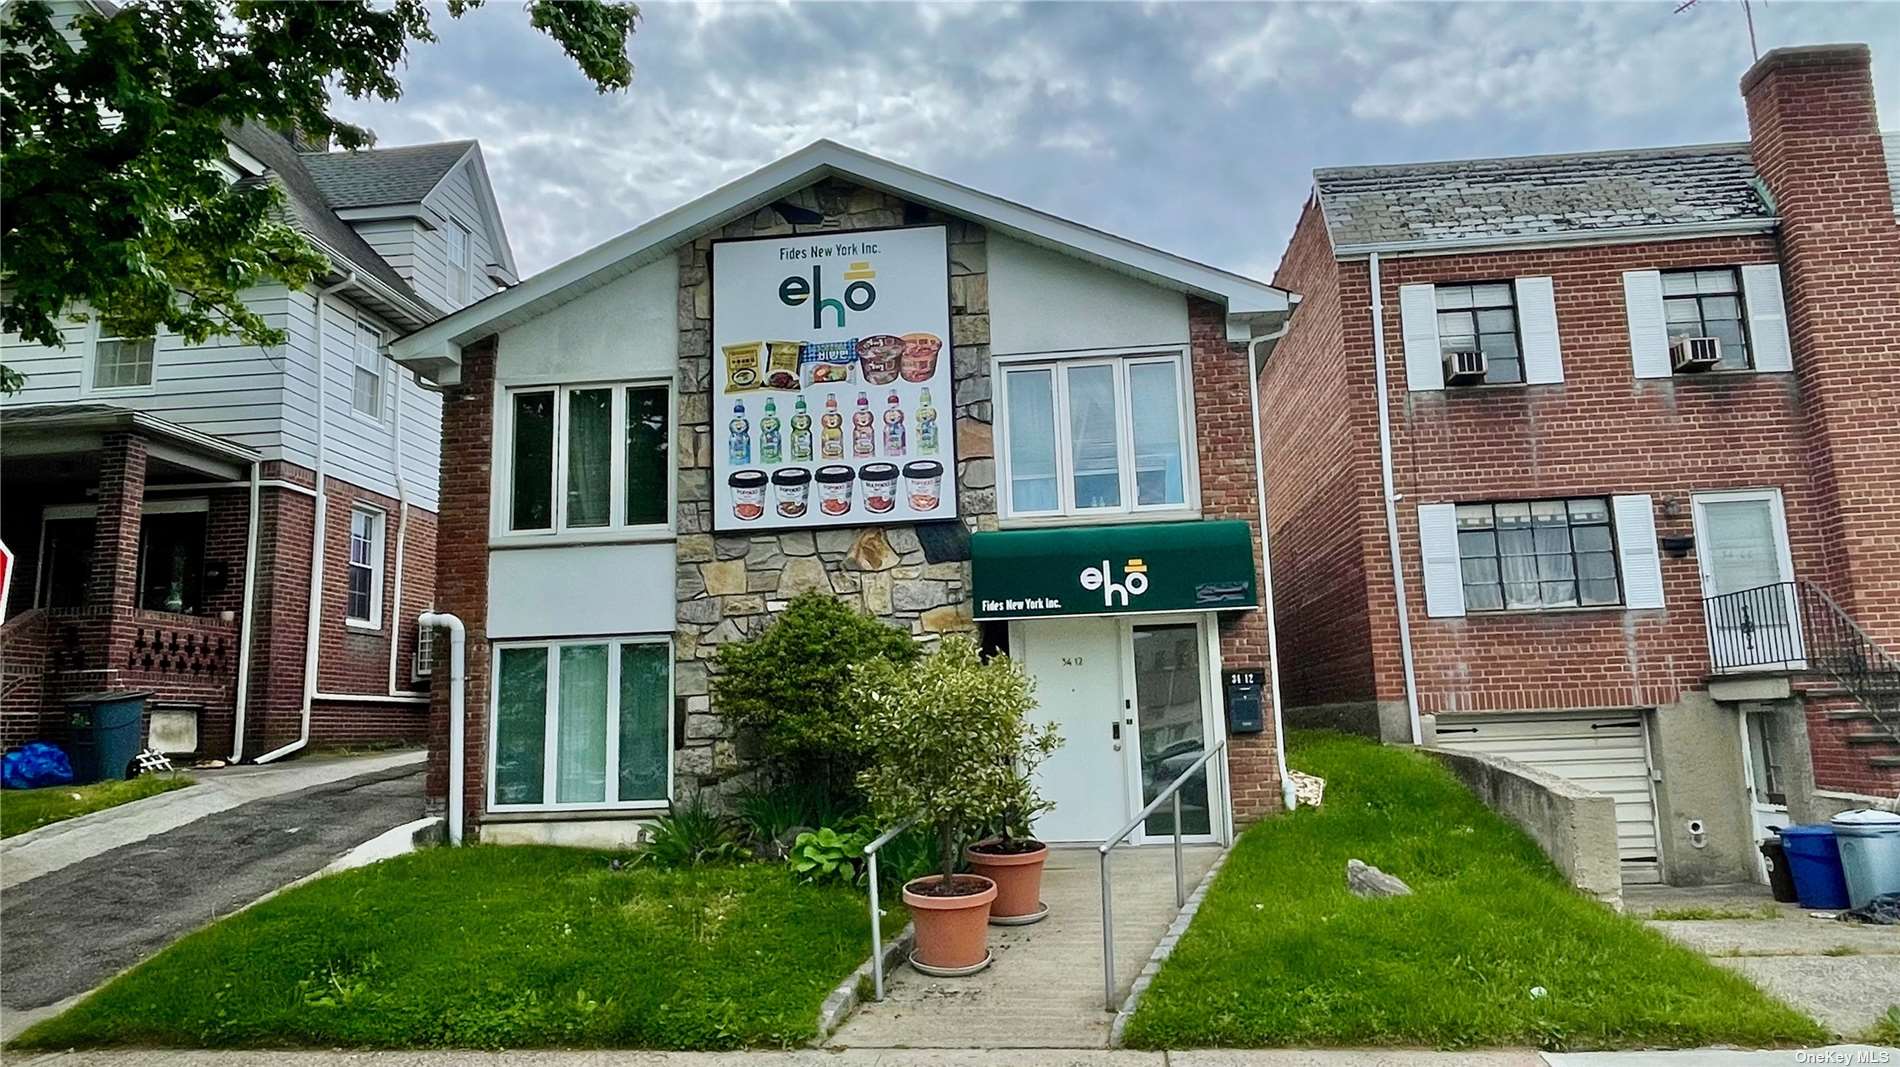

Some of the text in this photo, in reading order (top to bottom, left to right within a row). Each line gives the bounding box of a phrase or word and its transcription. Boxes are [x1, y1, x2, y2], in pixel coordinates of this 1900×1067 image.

[780, 242, 881, 260] Fides New York Inc.
[982, 598, 1061, 611] Fides New York Inc.
